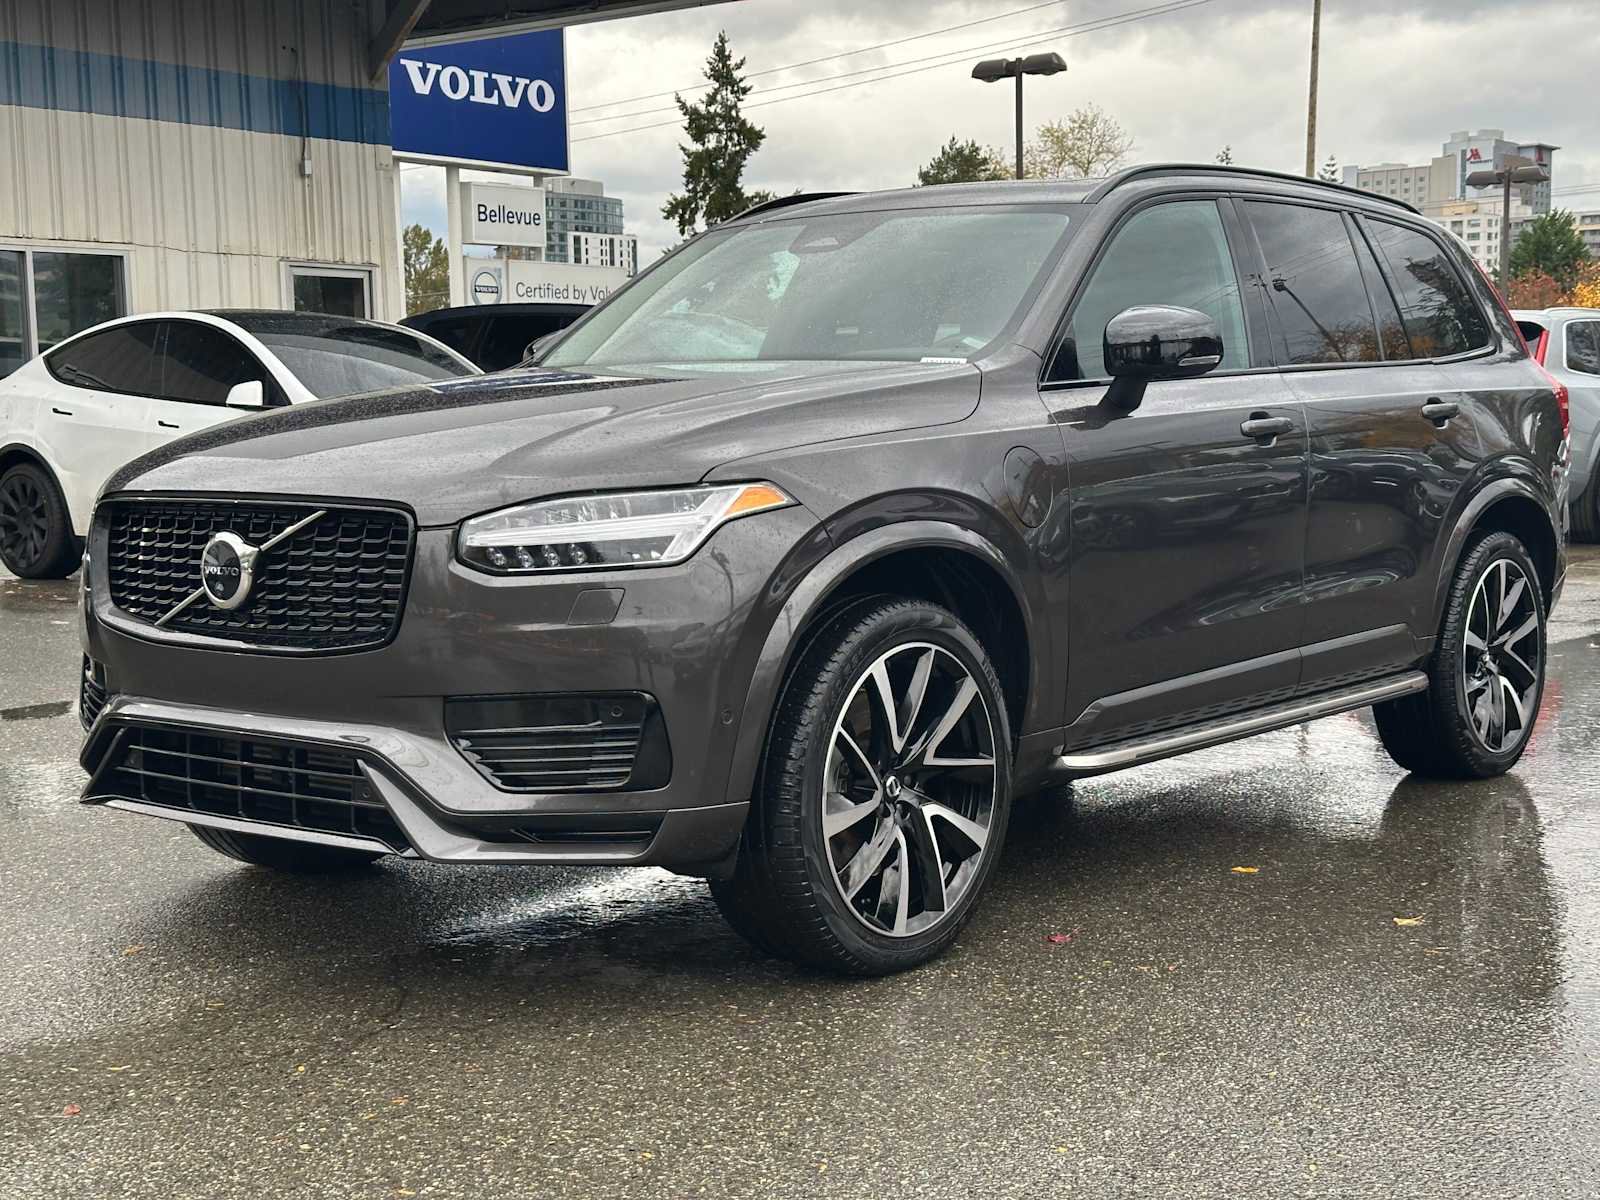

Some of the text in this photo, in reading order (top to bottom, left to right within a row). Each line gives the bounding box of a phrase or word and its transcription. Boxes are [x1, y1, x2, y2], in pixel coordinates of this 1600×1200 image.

[400, 58, 555, 113] VOLVO
[477, 203, 541, 226] Bellevue
[516, 282, 569, 300] Certified
[573, 284, 587, 303] by
[204, 566, 240, 576] VOLVO
